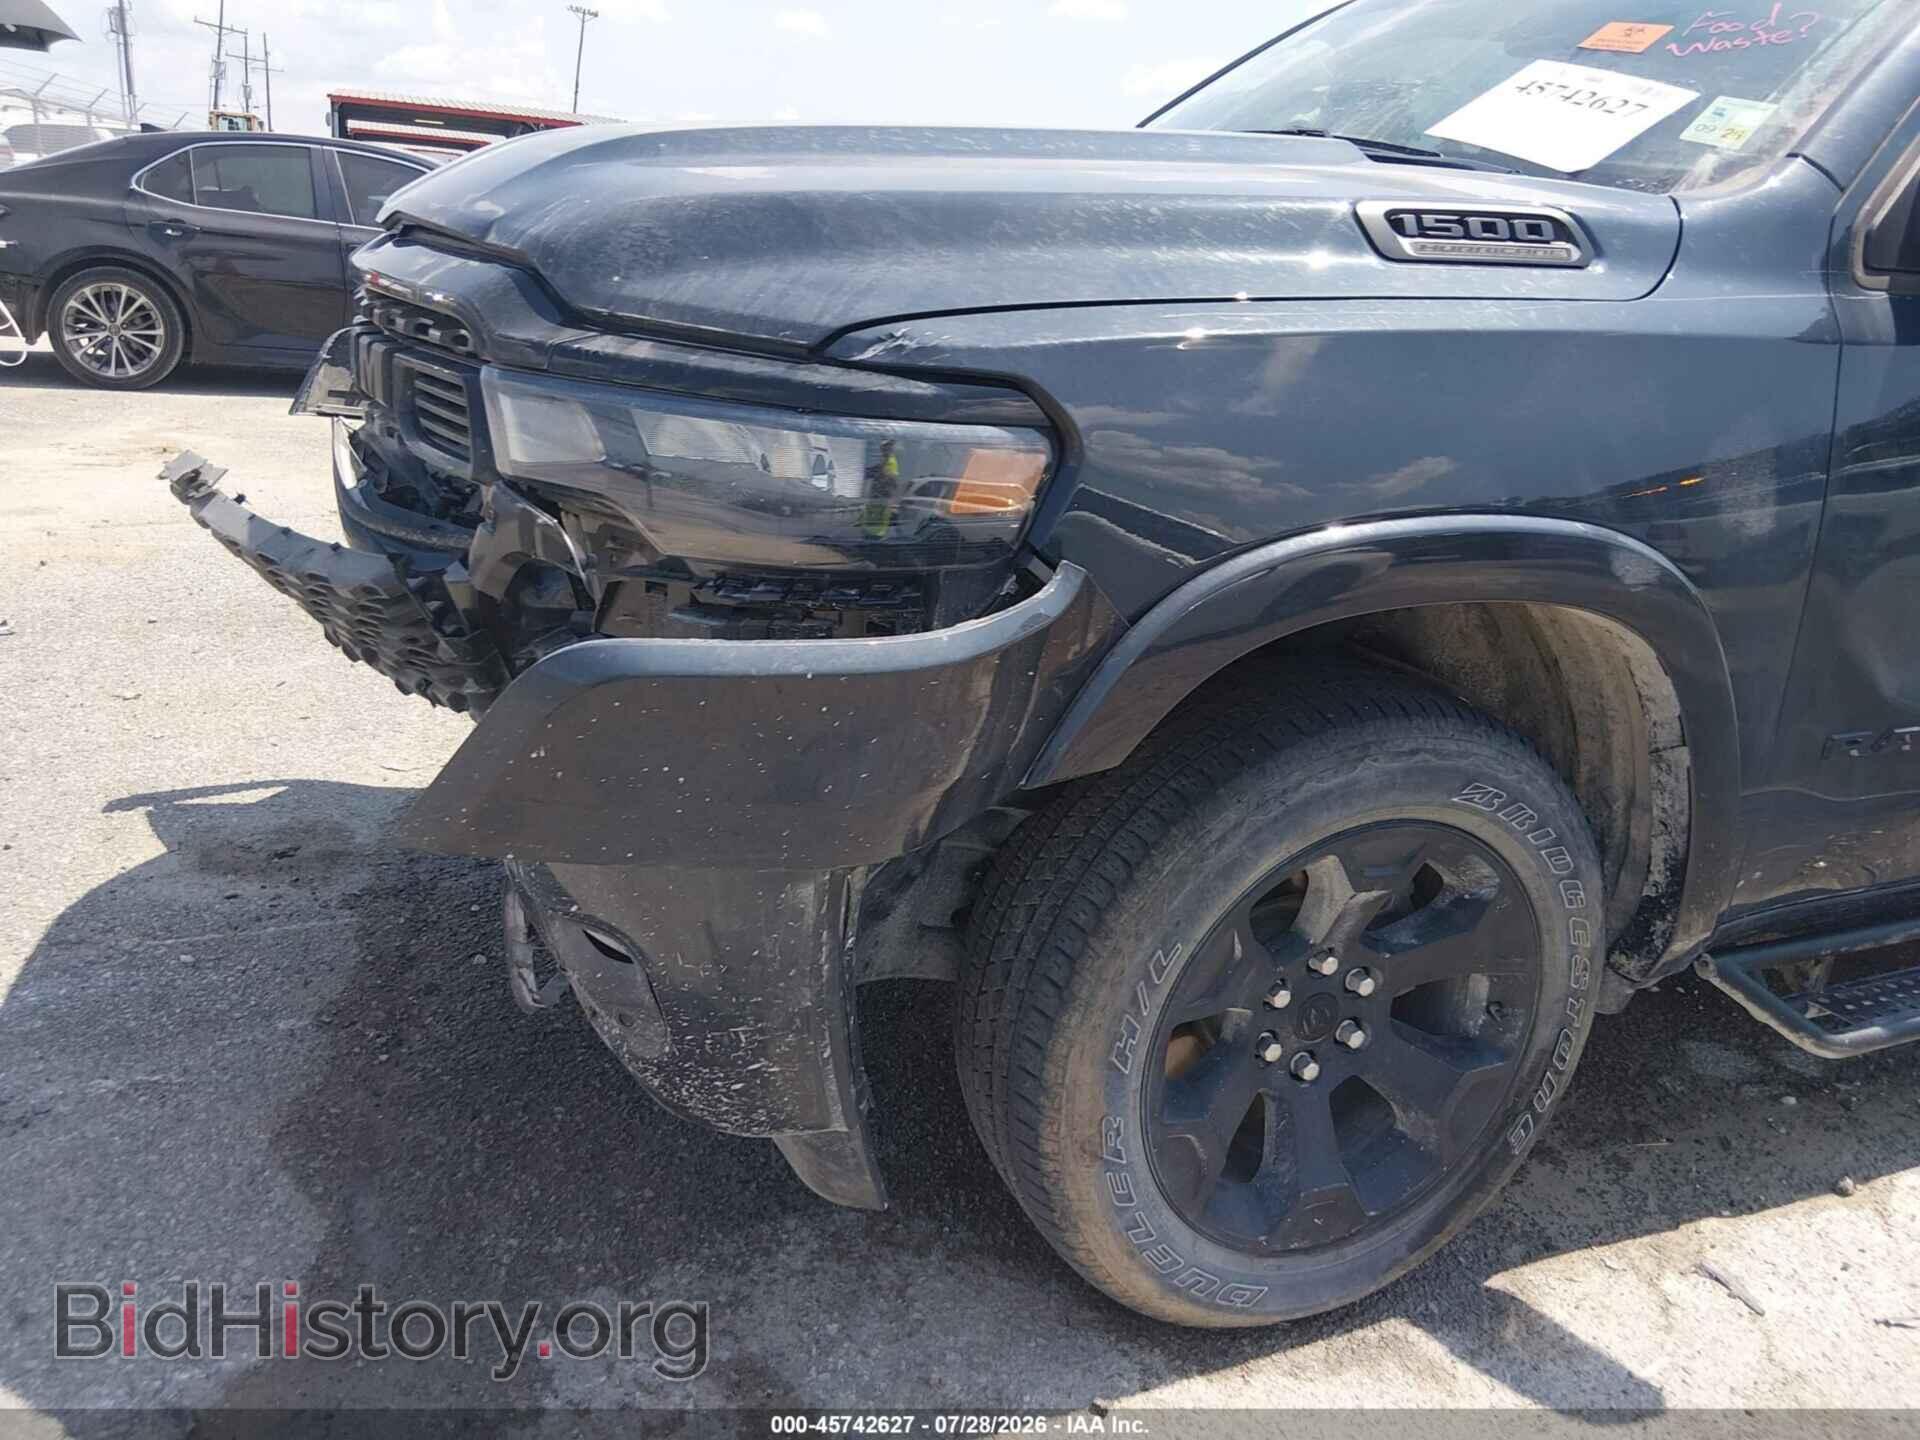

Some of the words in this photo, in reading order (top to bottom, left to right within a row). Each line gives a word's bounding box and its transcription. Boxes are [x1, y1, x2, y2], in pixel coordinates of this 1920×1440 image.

[1681, 2, 1782, 37] Food
[1515, 79, 1649, 117] 45742627
[1390, 213, 1555, 241] 1500
[1452, 782, 1591, 1156] BRIDGESTONE
[1102, 1115, 1269, 1308] DUELER
